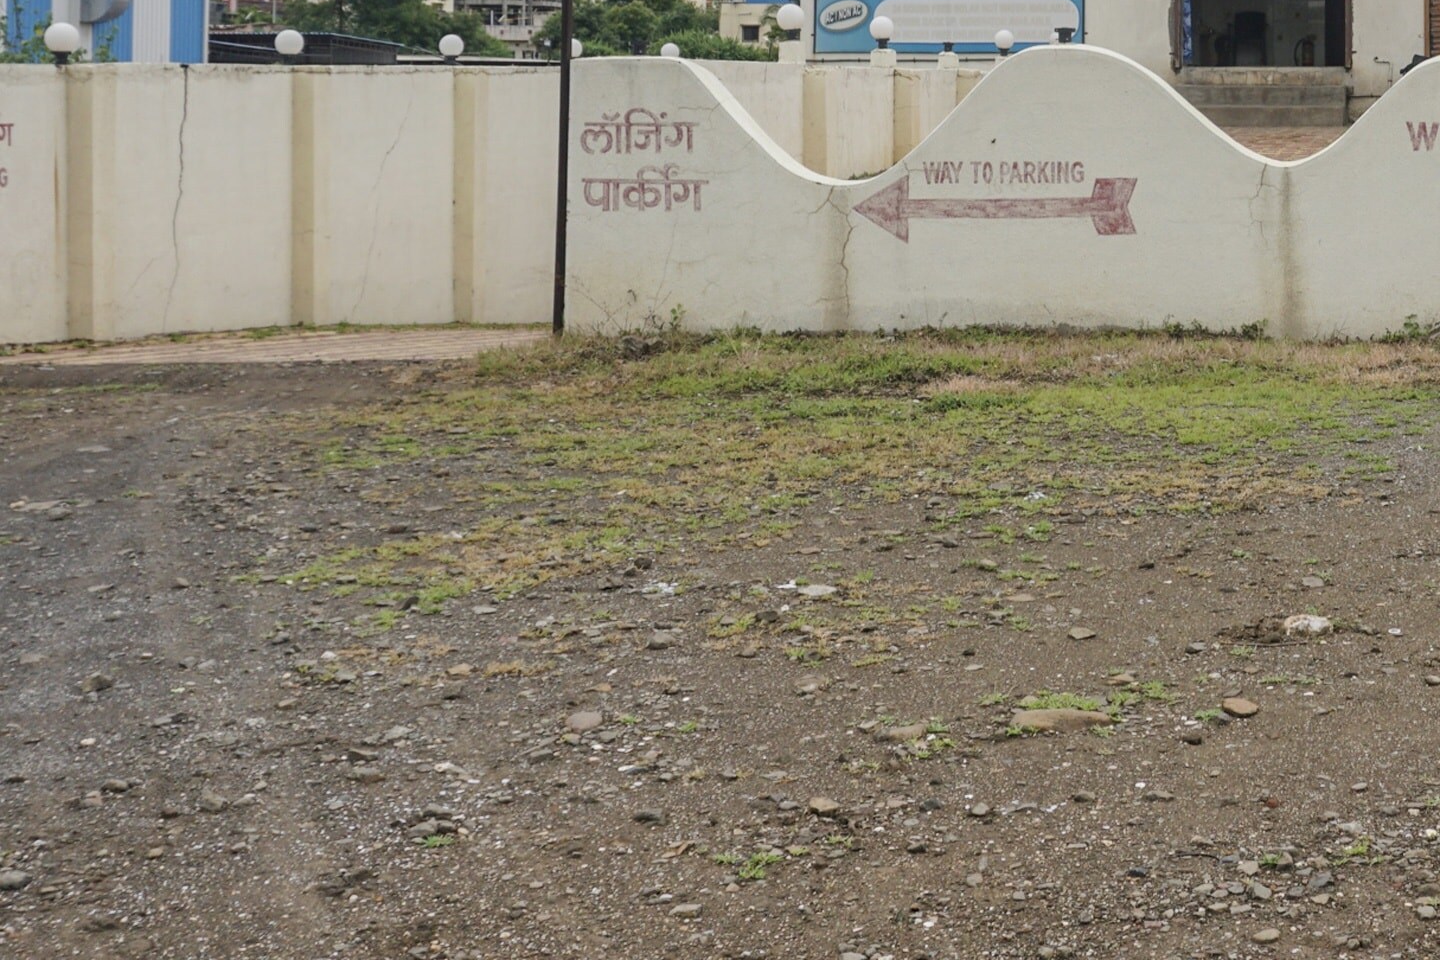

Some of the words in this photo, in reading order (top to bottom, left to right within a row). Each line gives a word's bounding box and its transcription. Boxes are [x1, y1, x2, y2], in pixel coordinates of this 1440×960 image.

[922, 161, 963, 185] WAY
[970, 161, 994, 184] TO
[999, 161, 1085, 184] PARKING
